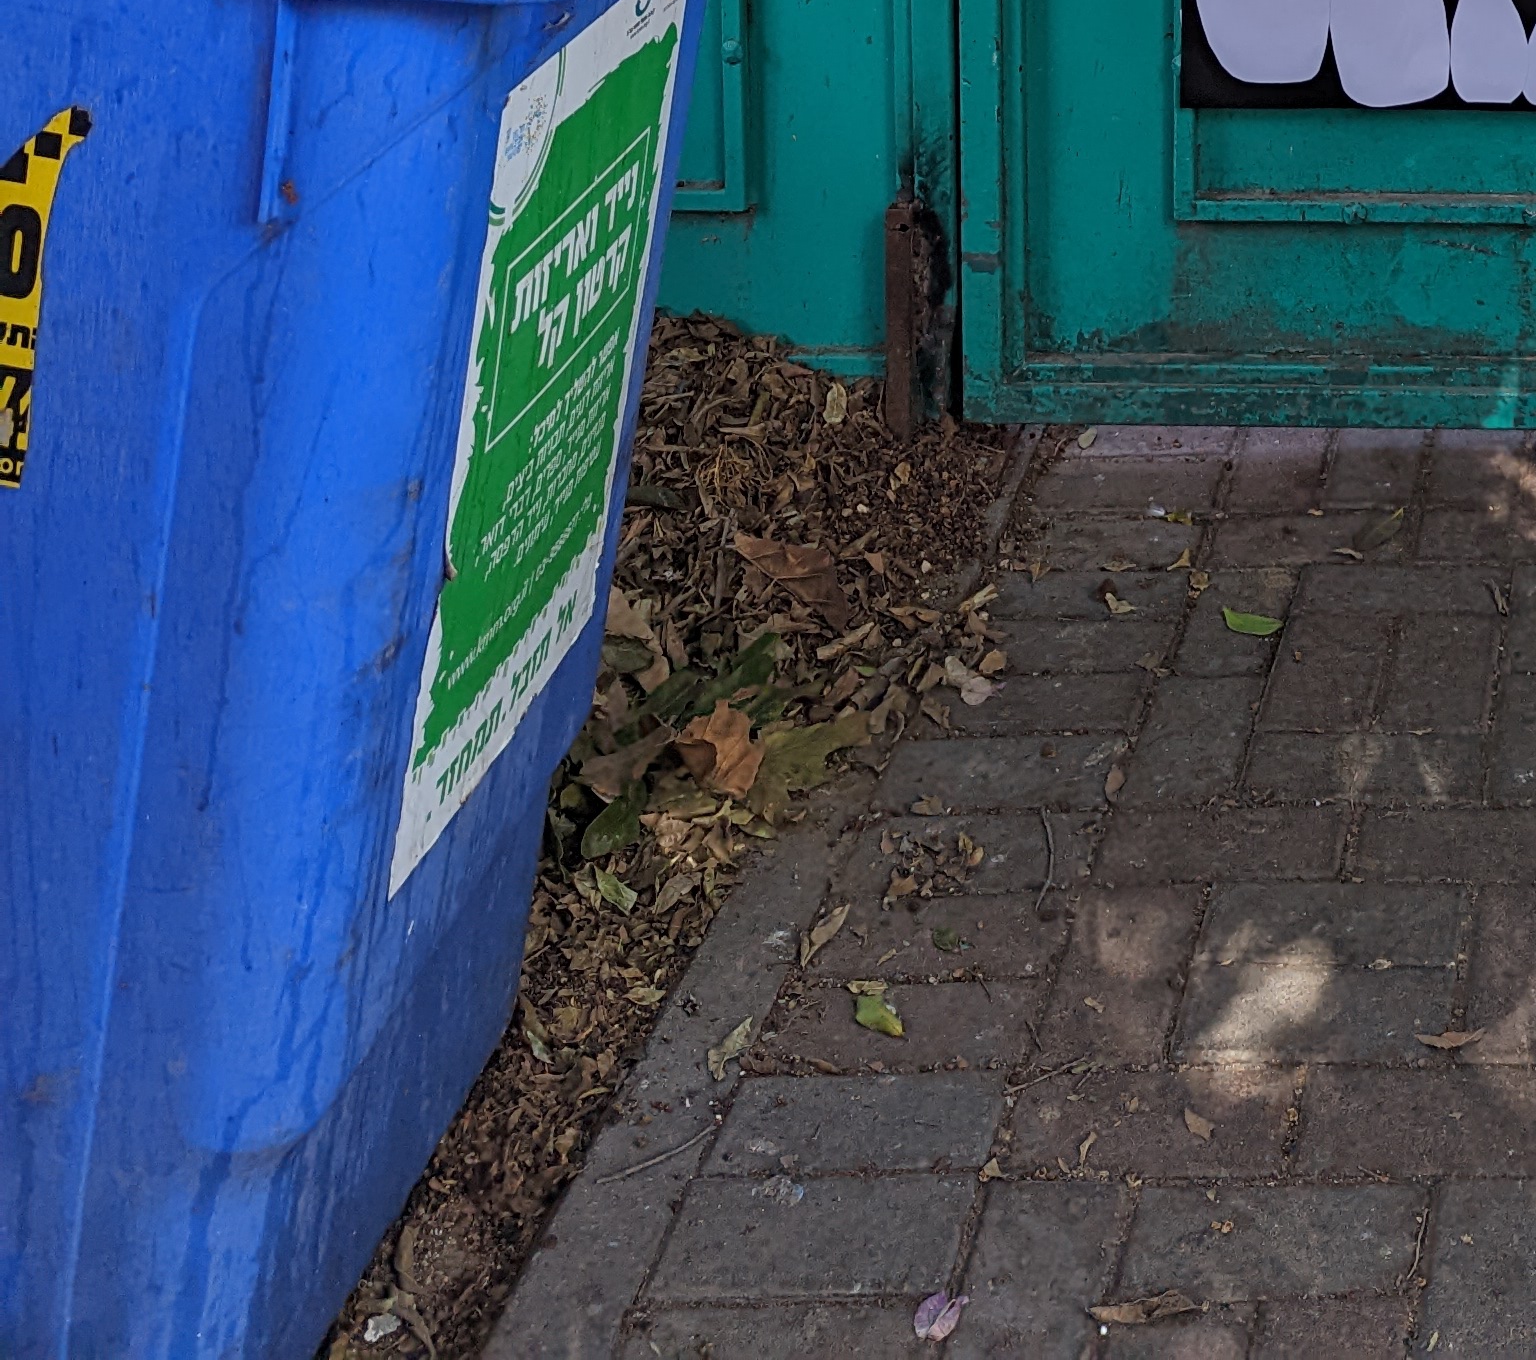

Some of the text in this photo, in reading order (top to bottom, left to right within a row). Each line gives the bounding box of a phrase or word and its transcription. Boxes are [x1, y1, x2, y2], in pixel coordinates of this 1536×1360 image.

[511, 160, 639, 333] נייר ואריזות
[538, 223, 632, 367] קרטון קל
[529, 398, 563, 453] למיכל:
[556, 589, 578, 644] אל
